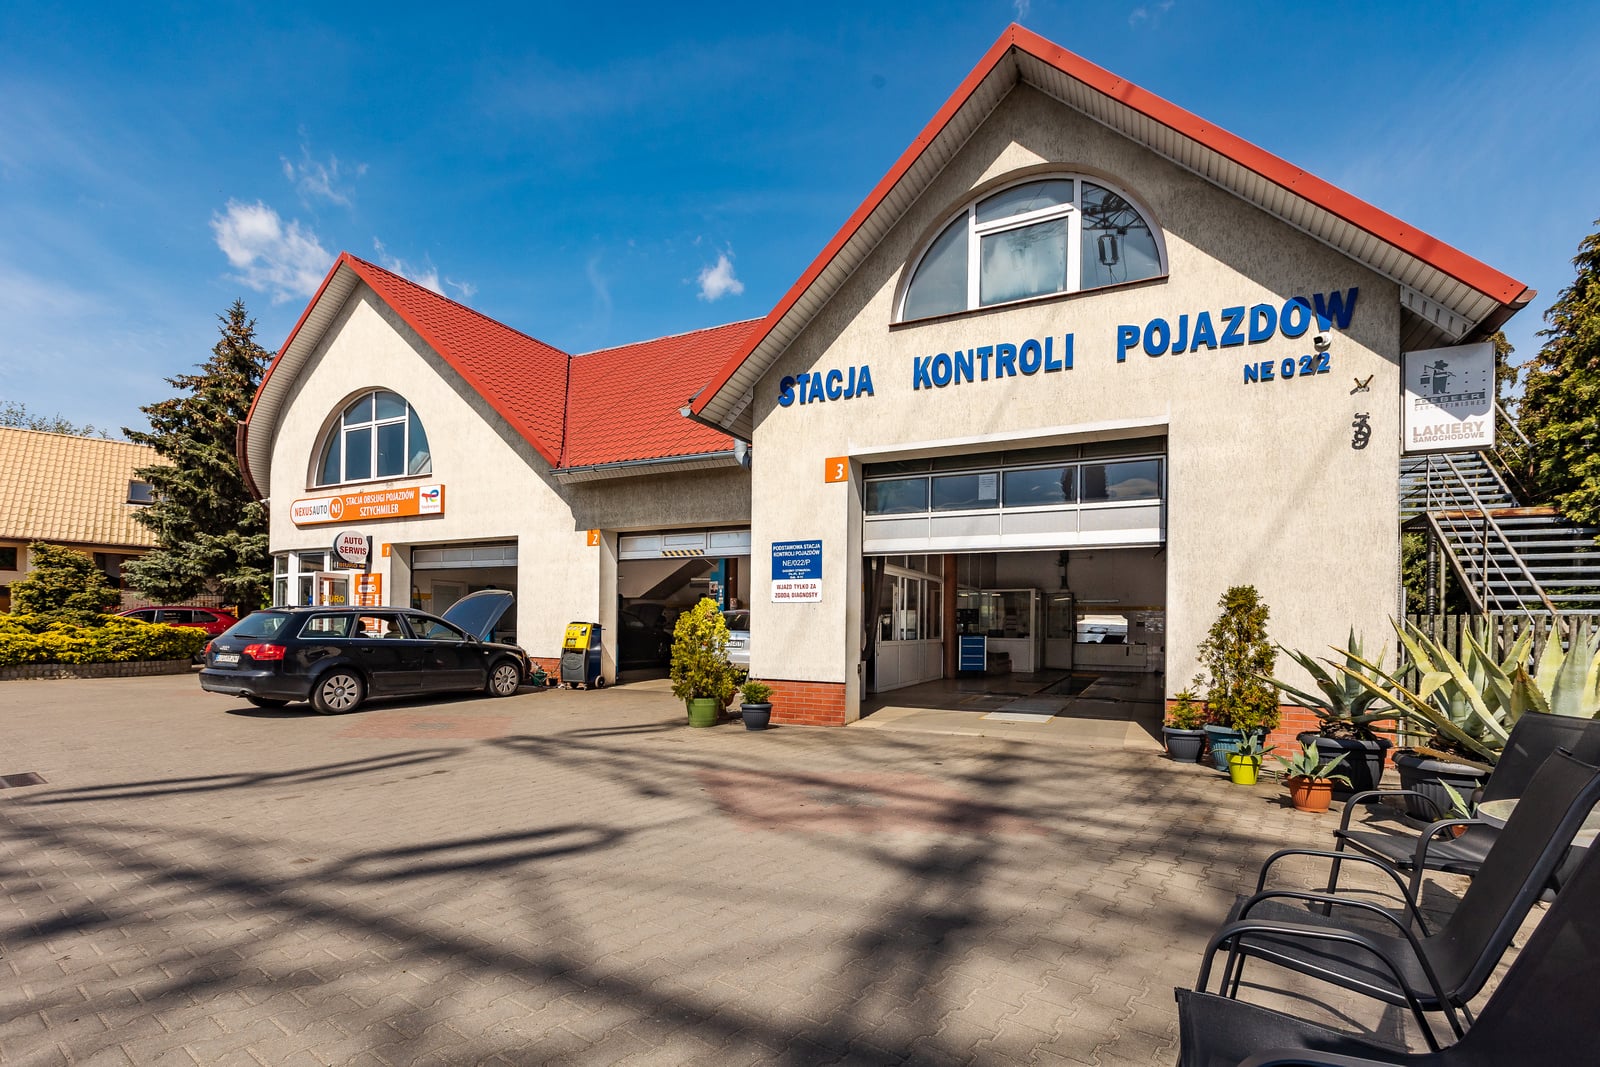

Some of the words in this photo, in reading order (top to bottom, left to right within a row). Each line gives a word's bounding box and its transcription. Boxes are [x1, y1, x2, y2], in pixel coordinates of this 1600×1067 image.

[778, 365, 874, 407] STACJA
[913, 333, 1074, 390] KONTROLI
[1244, 361, 1275, 384] NE
[1281, 352, 1331, 378] 022
[1413, 421, 1485, 437] LAKIERY
[1413, 432, 1485, 443] SAMOCHODOWE
[834, 463, 844, 479] 3
[345, 496, 363, 505] STACJA
[363, 493, 385, 505] OBSŁUGI
[385, 490, 415, 503] POJAZDÓW
[294, 504, 328, 517] NEXUSAUTO
[331, 503, 341, 514] N!
[359, 504, 399, 517] SZTYCHMILER
[344, 536, 363, 546] AUTO
[592, 533, 598, 545] 2
[339, 545, 367, 556] SERWIS
